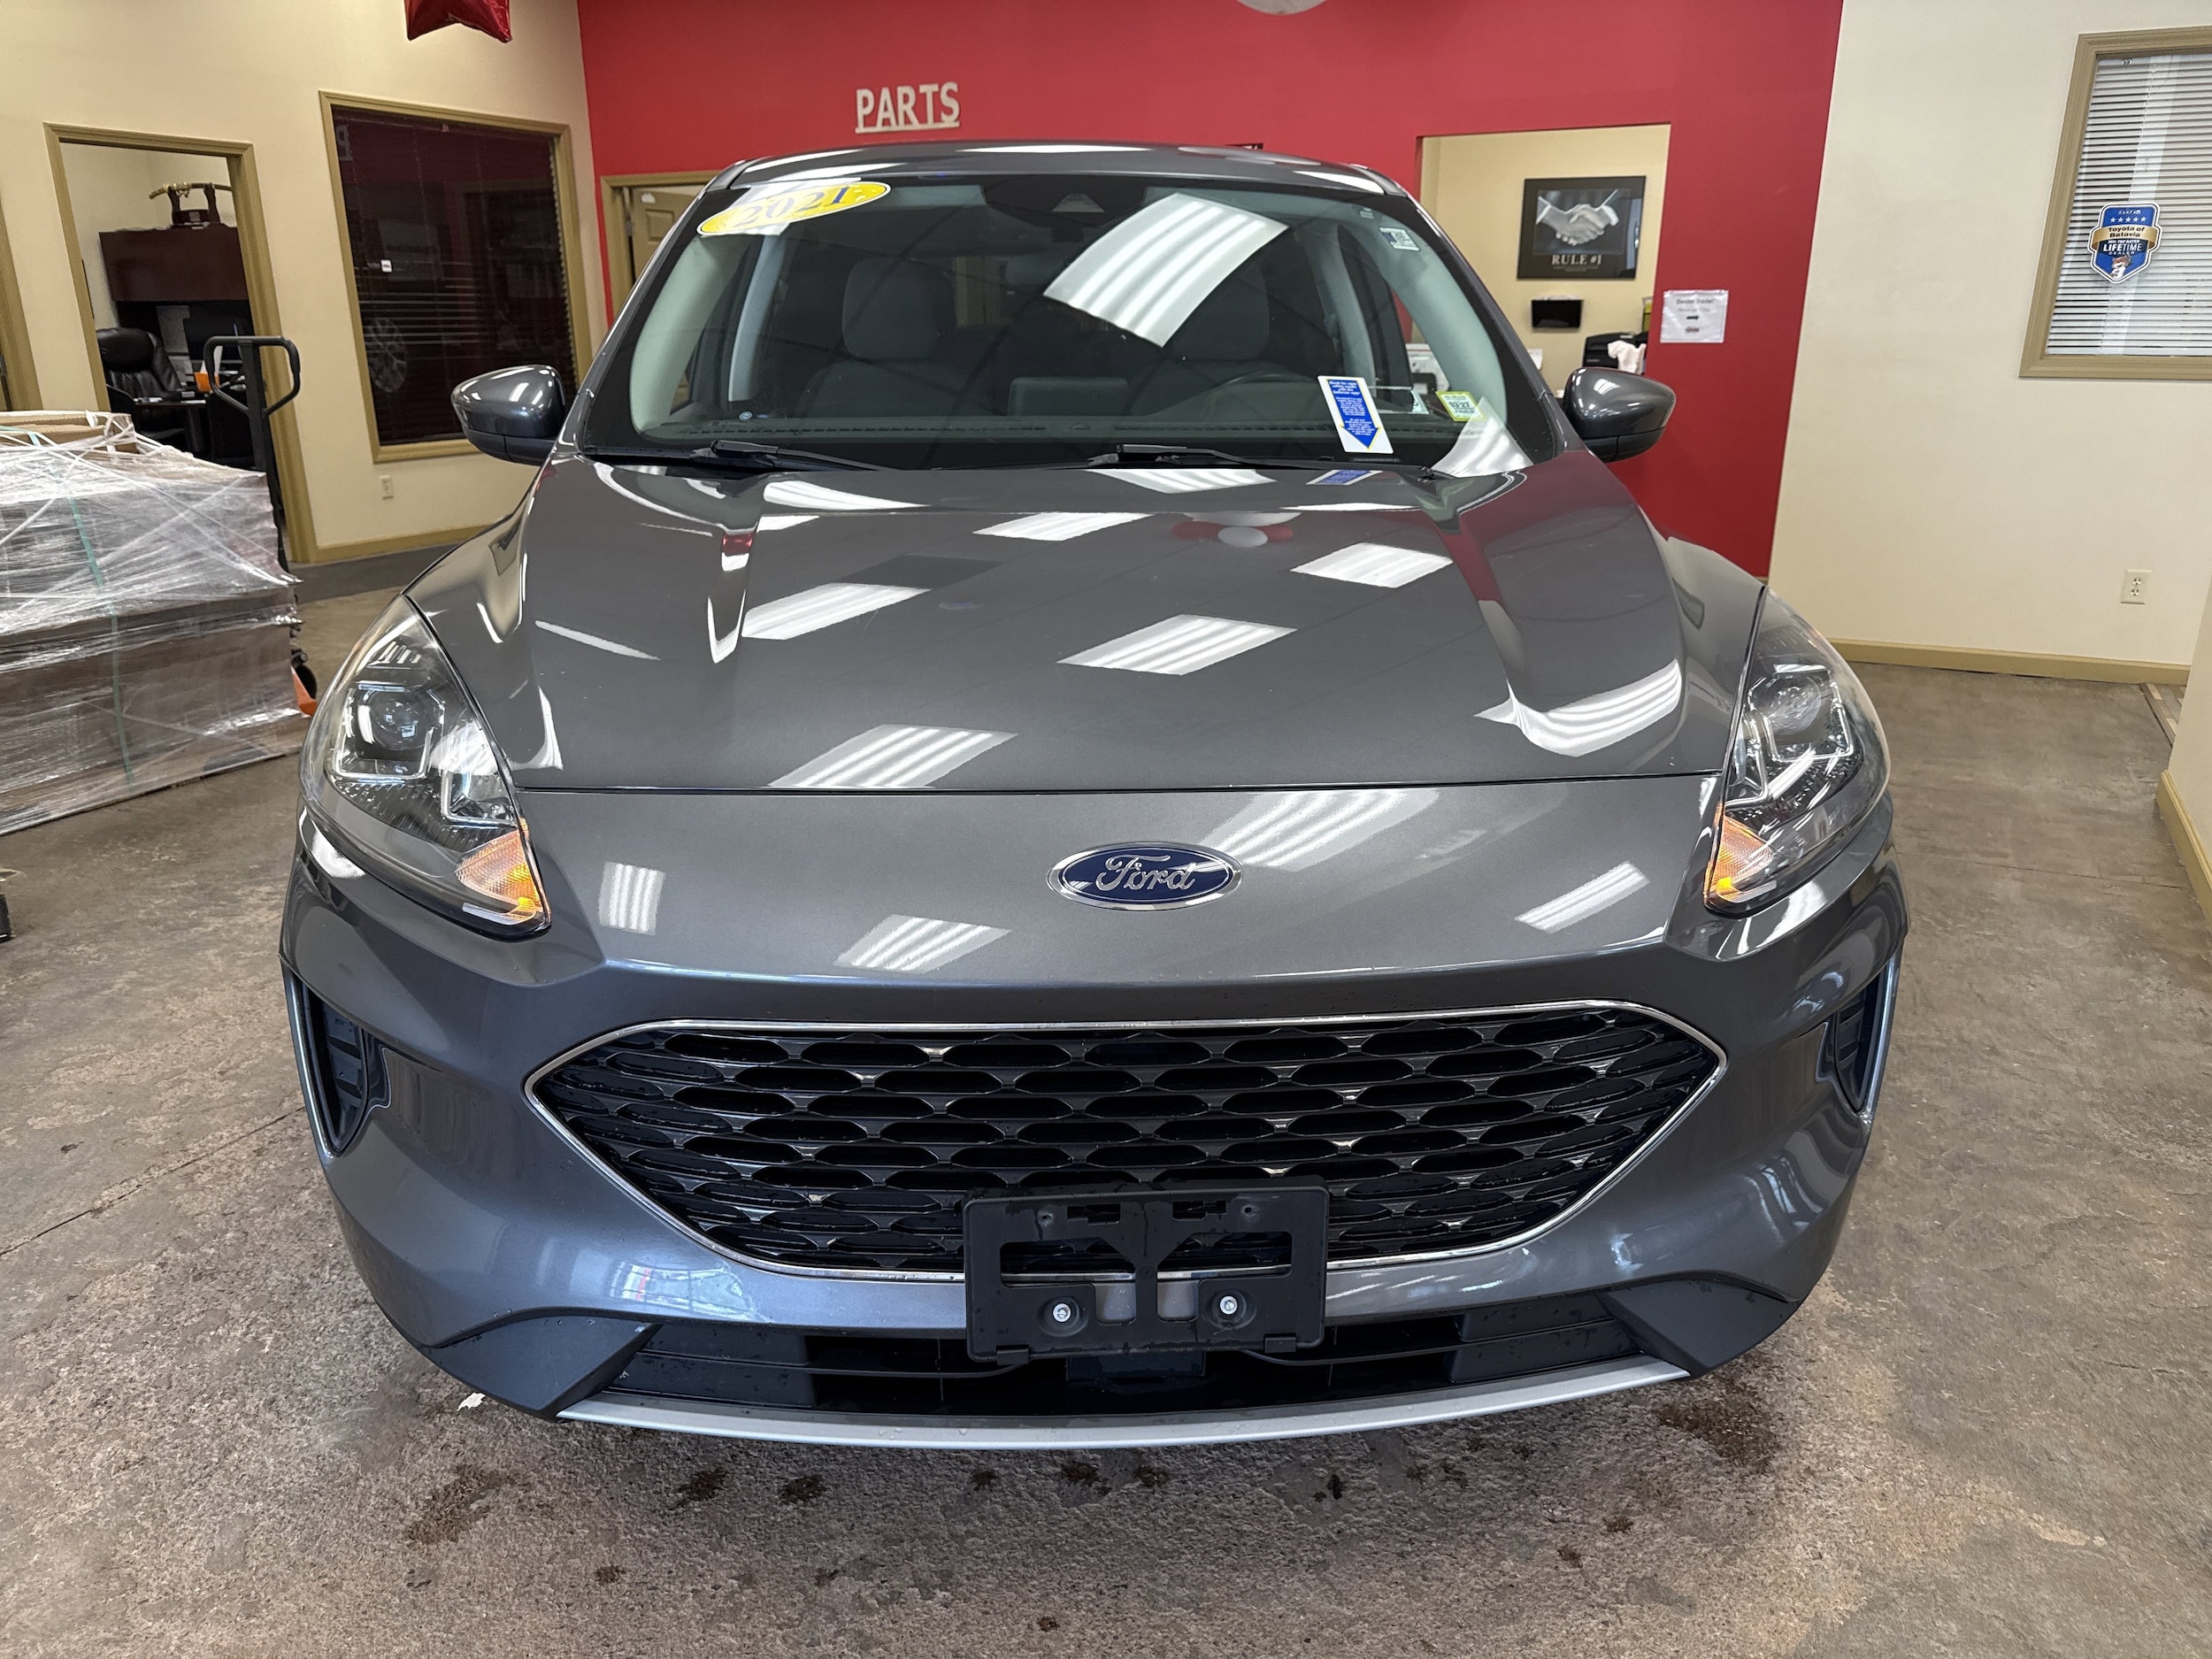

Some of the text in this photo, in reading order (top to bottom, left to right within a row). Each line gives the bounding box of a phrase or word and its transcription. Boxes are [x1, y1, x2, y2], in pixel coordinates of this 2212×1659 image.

[856, 81, 960, 131] PARTS
[734, 187, 850, 228] 2021
[1552, 254, 1587, 265] RULE
[2103, 243, 2142, 252] LIFETIME
[1095, 855, 1195, 891] Ford
